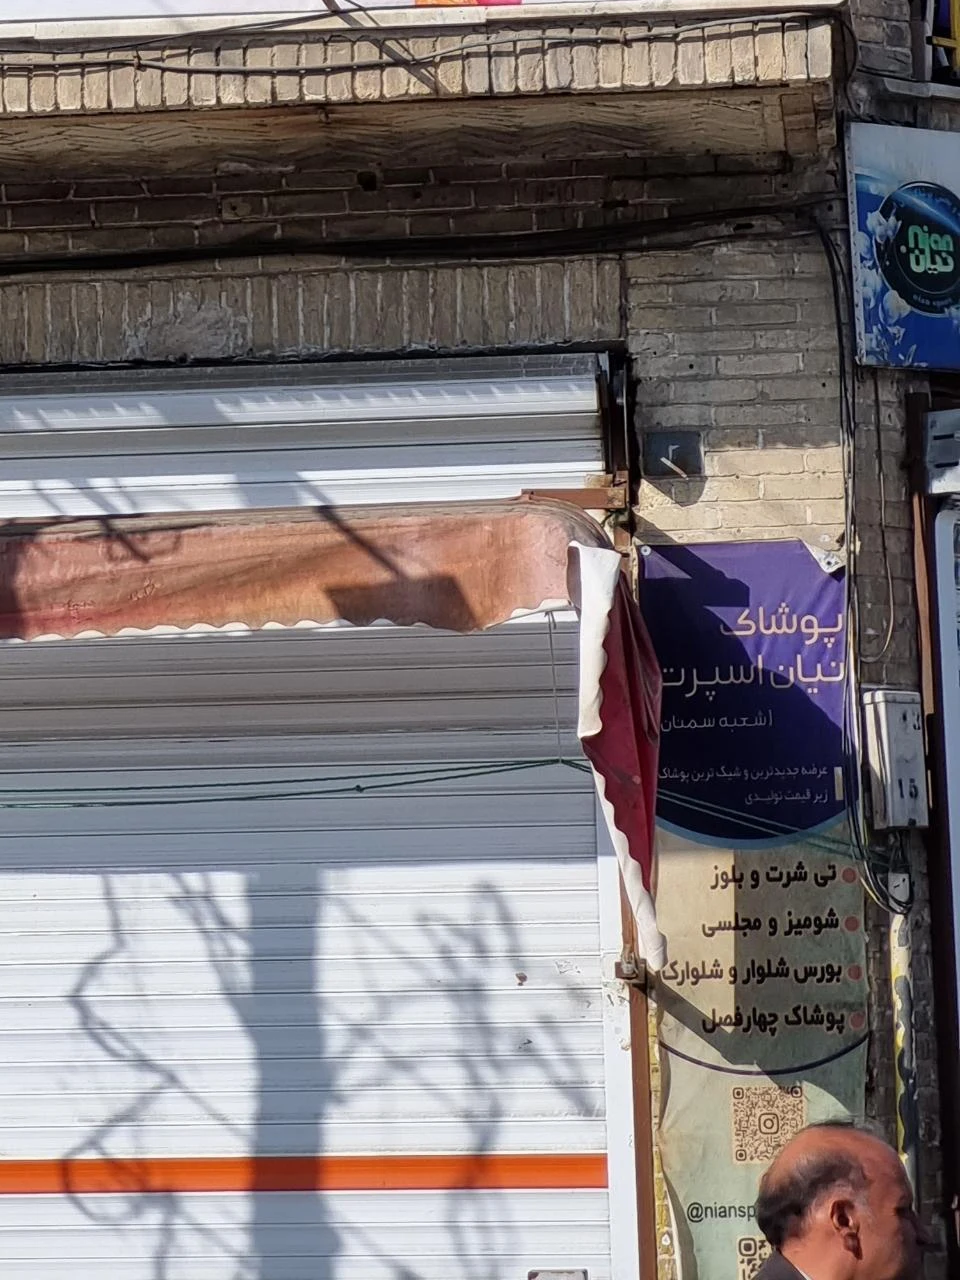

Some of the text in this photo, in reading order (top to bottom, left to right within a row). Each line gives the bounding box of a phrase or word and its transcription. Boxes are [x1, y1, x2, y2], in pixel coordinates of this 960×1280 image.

[720, 602, 843, 648] پوشاک
[662, 654, 845, 701] نیان اسپرت
[661, 714, 715, 732] سمنان
[710, 861, 837, 890] تی شرت و بلوز
[701, 908, 840, 937] شومیز و مجلسی
[662, 957, 842, 986] بورس شلوار و شلوارک
[784, 1004, 845, 1035] پوشاک
[686, 1201, 757, 1223] @niansp
